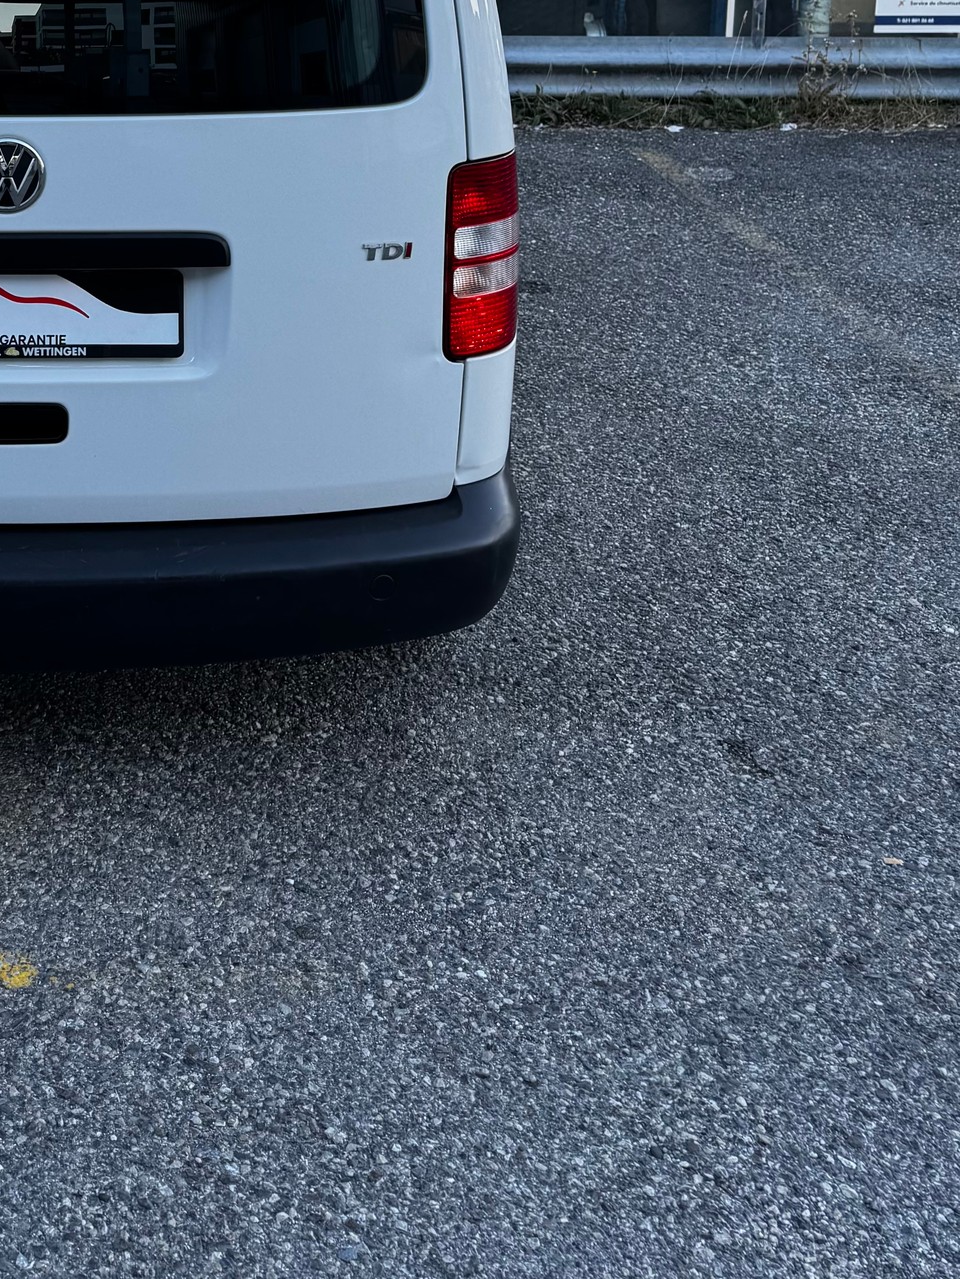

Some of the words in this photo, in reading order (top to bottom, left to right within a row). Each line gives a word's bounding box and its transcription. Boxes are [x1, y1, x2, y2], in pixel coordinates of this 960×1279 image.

[362, 242, 413, 261] TDI
[0, 334, 67, 345] GARANTIE
[21, 347, 87, 357] WETTINGEN
